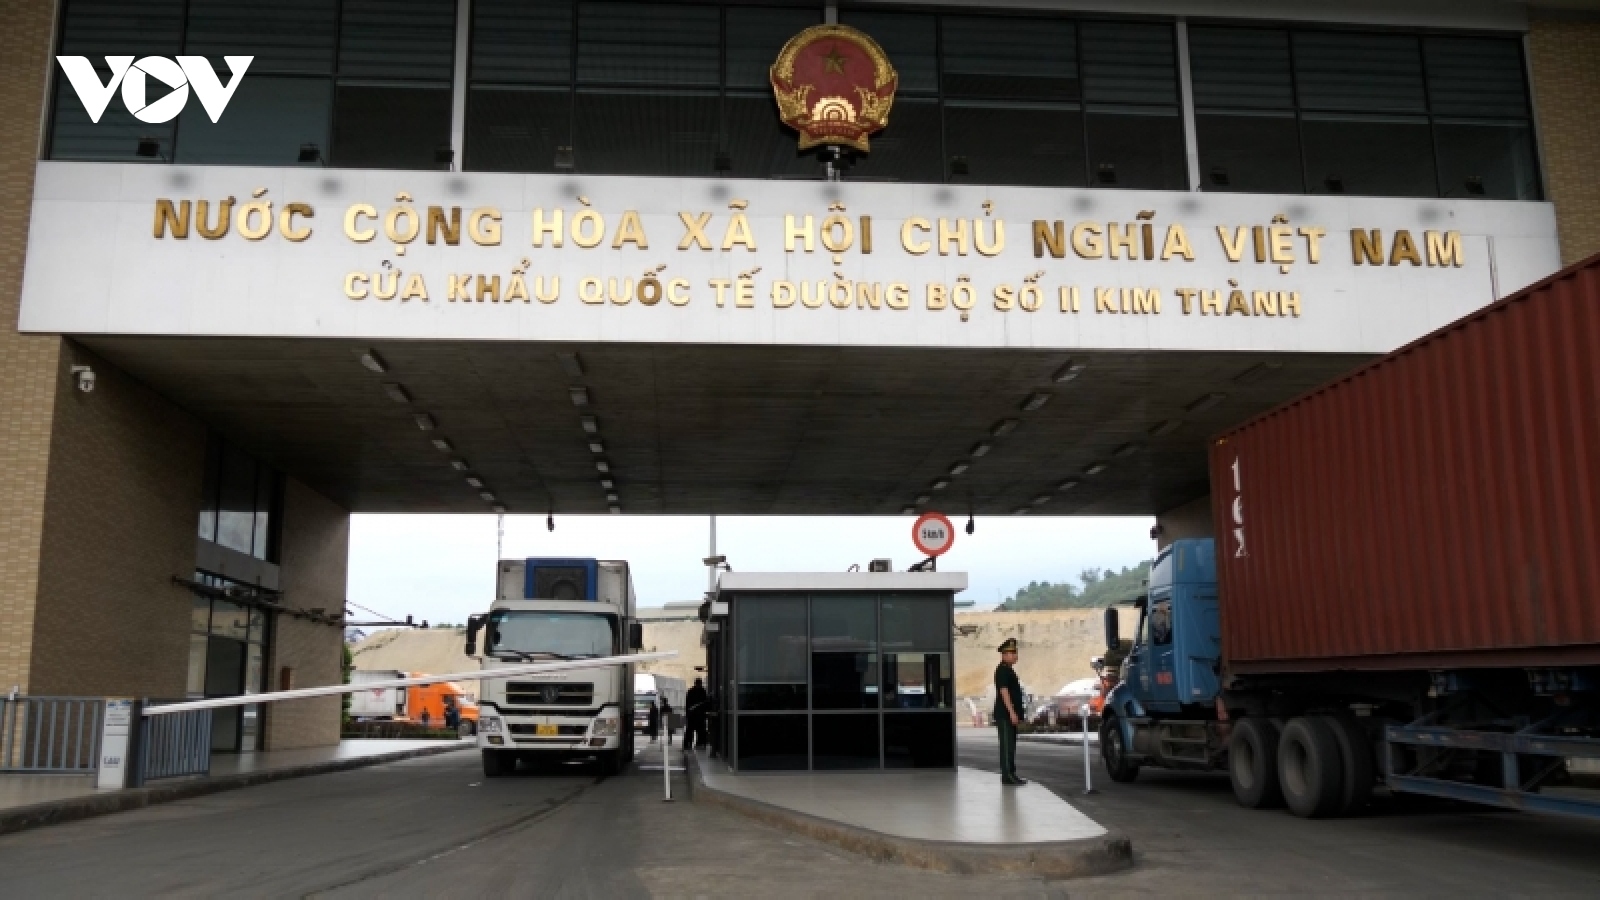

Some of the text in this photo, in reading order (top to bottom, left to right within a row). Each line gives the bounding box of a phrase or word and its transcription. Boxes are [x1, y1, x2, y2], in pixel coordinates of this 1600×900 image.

[153, 187, 1464, 274] NƯỚC CỘNG HÒA XÃ HỘI CHỦ NGHĨA VIỆT NAM
[344, 257, 1302, 322] CỬA KHẨU QUỐC TẾ ĐƯỜNG BỘ SỐ II KIM THÀNH
